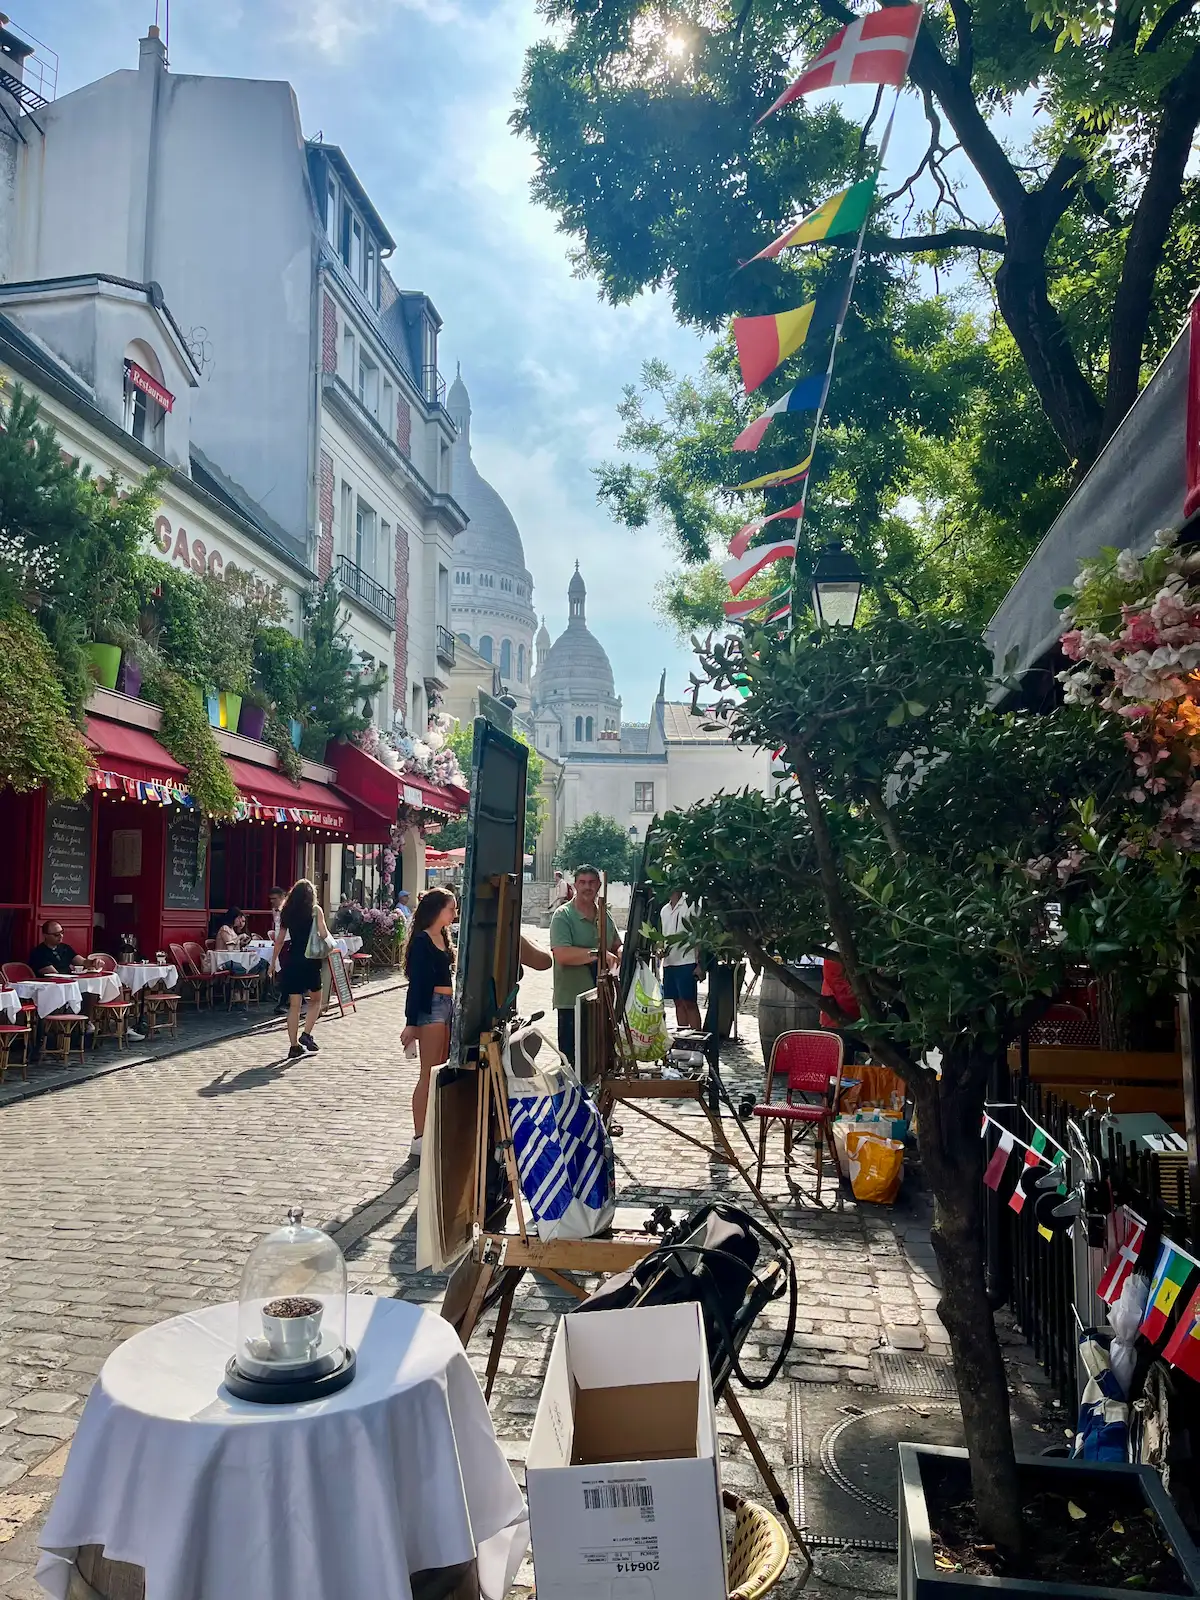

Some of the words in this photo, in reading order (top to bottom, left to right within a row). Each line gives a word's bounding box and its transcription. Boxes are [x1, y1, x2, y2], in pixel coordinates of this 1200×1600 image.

[133, 370, 169, 408] Restaurant
[155, 514, 282, 606] GASCN
[616, 1561, 660, 1573] 206414
